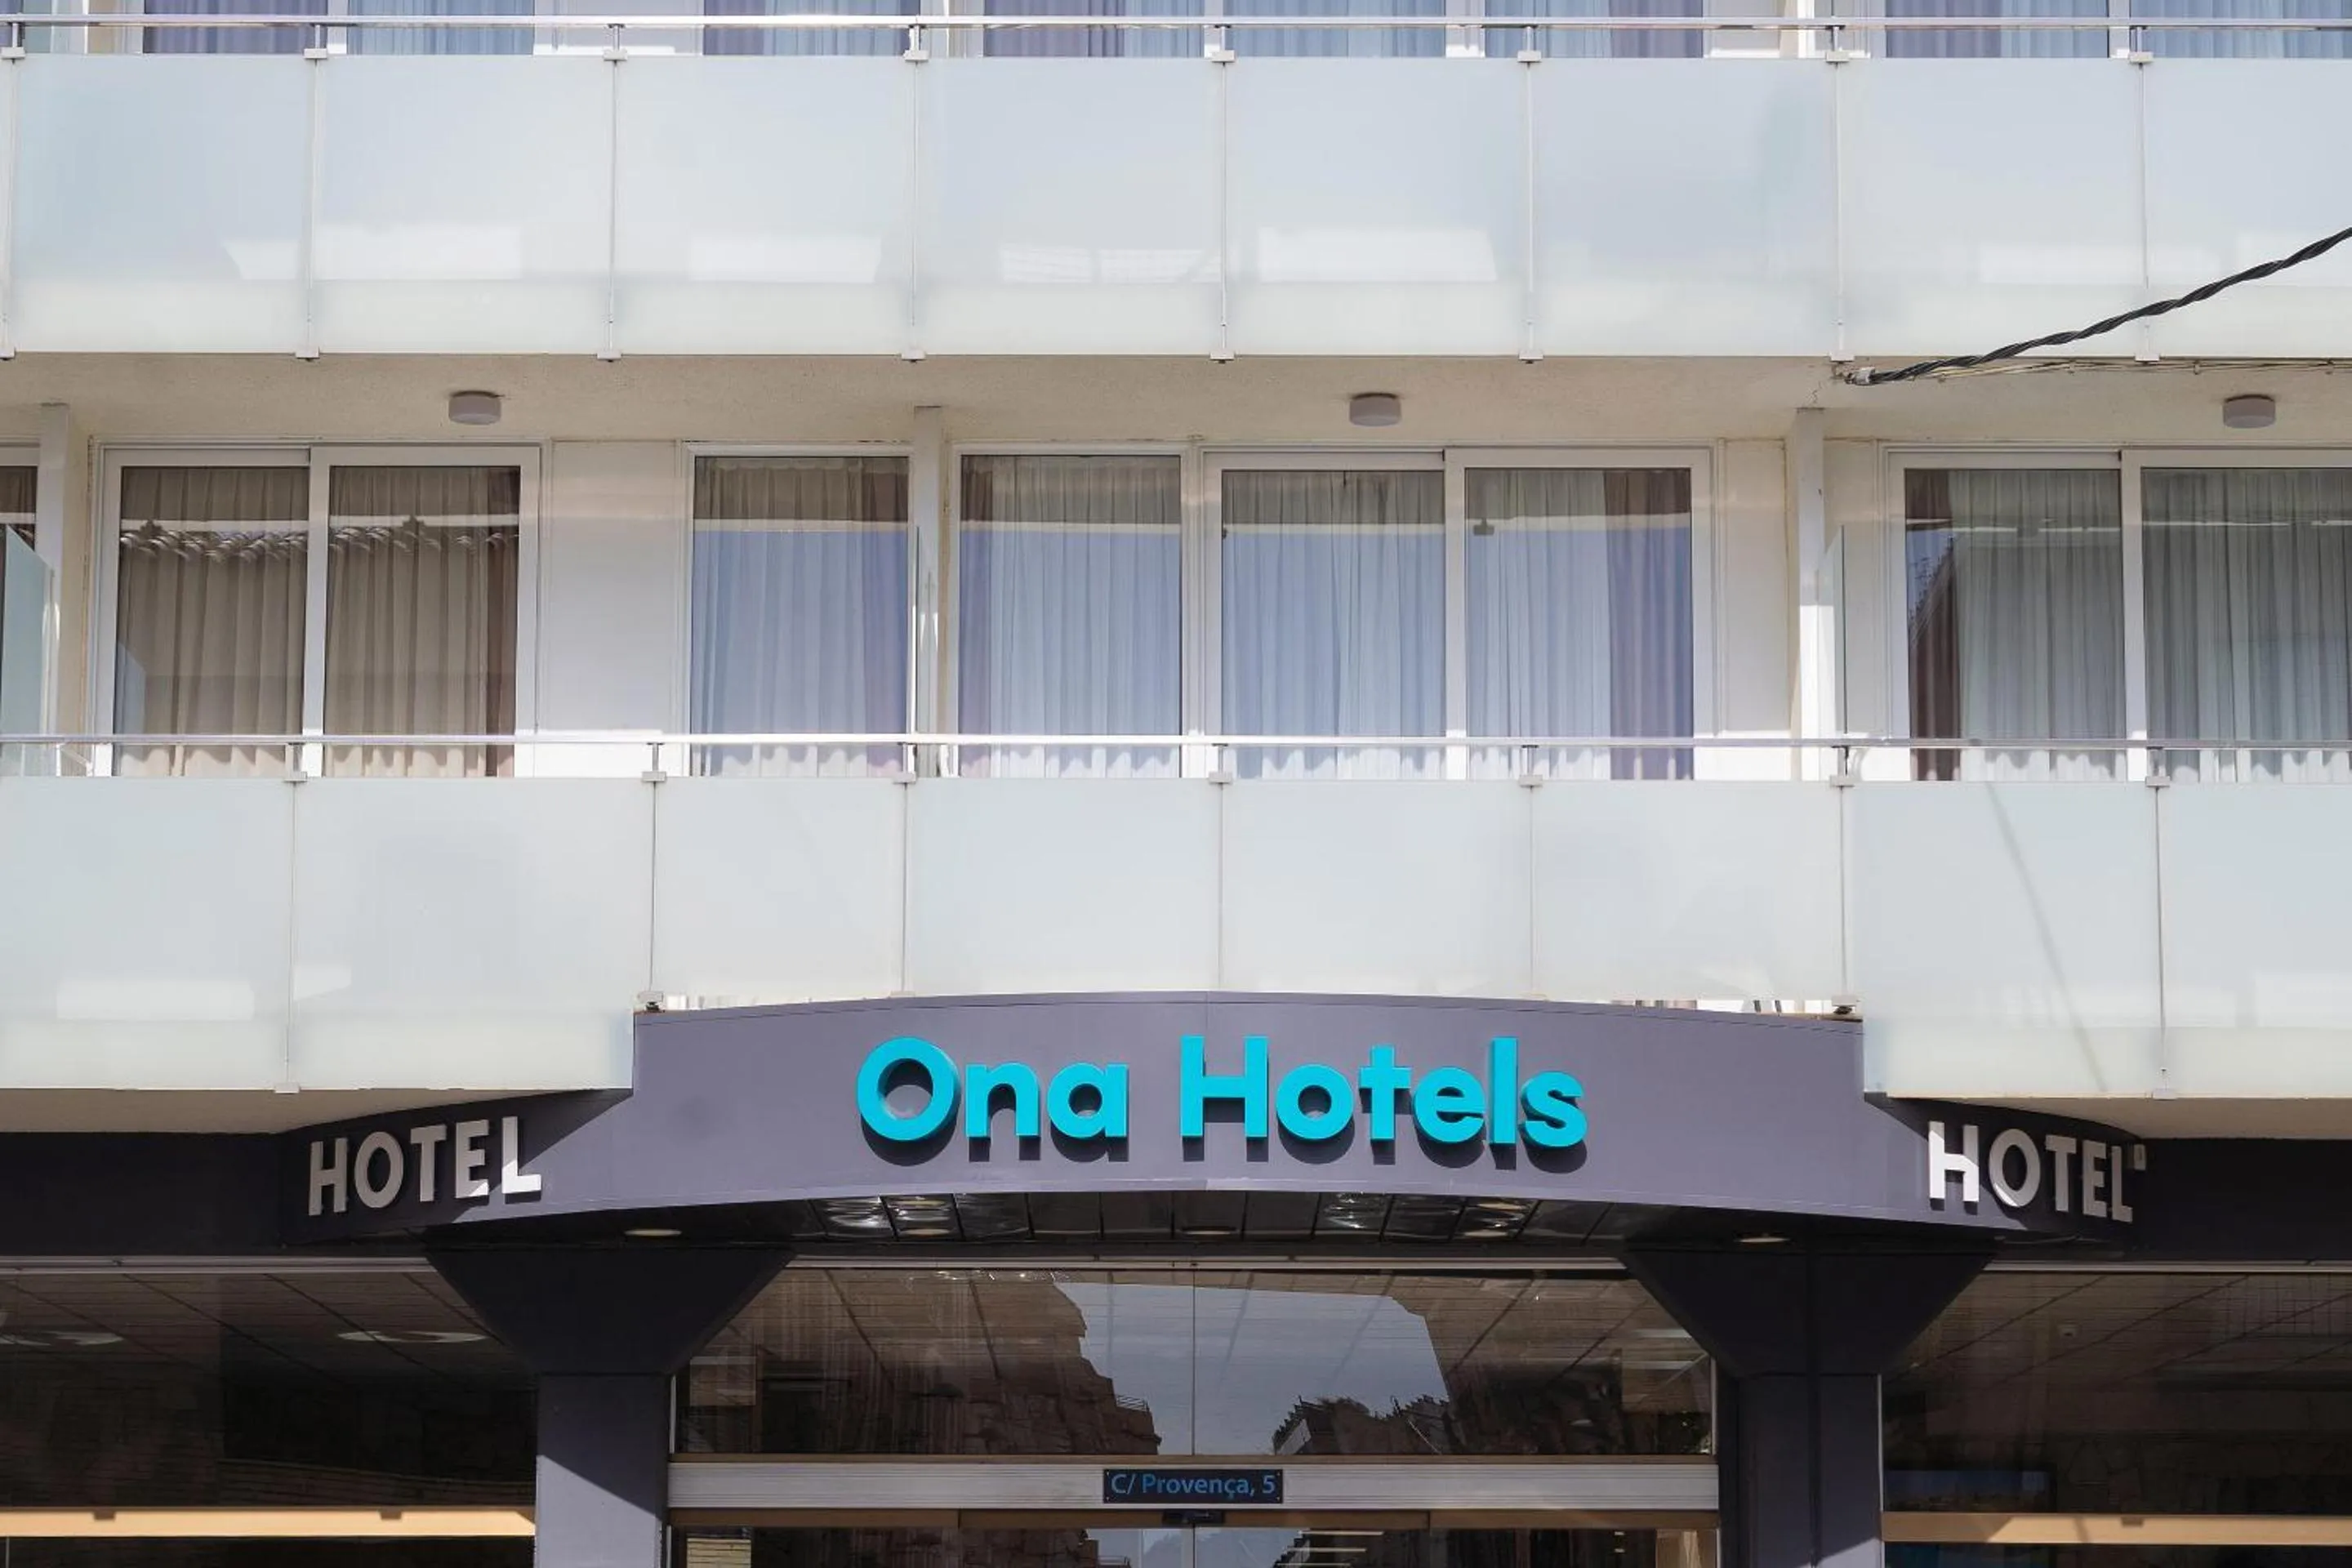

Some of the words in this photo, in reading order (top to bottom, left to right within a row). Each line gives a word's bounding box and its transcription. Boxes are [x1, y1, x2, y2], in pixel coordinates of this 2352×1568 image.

[857, 1037, 1128, 1140] Ona
[1181, 1036, 1586, 1147] Hotels
[309, 1116, 541, 1215] HOTEL
[1928, 1121, 2133, 1223] HOTEL
[1111, 1473, 1134, 1494] C/
[1143, 1473, 1255, 1499] Provença,
[1263, 1474, 1276, 1494] 5
